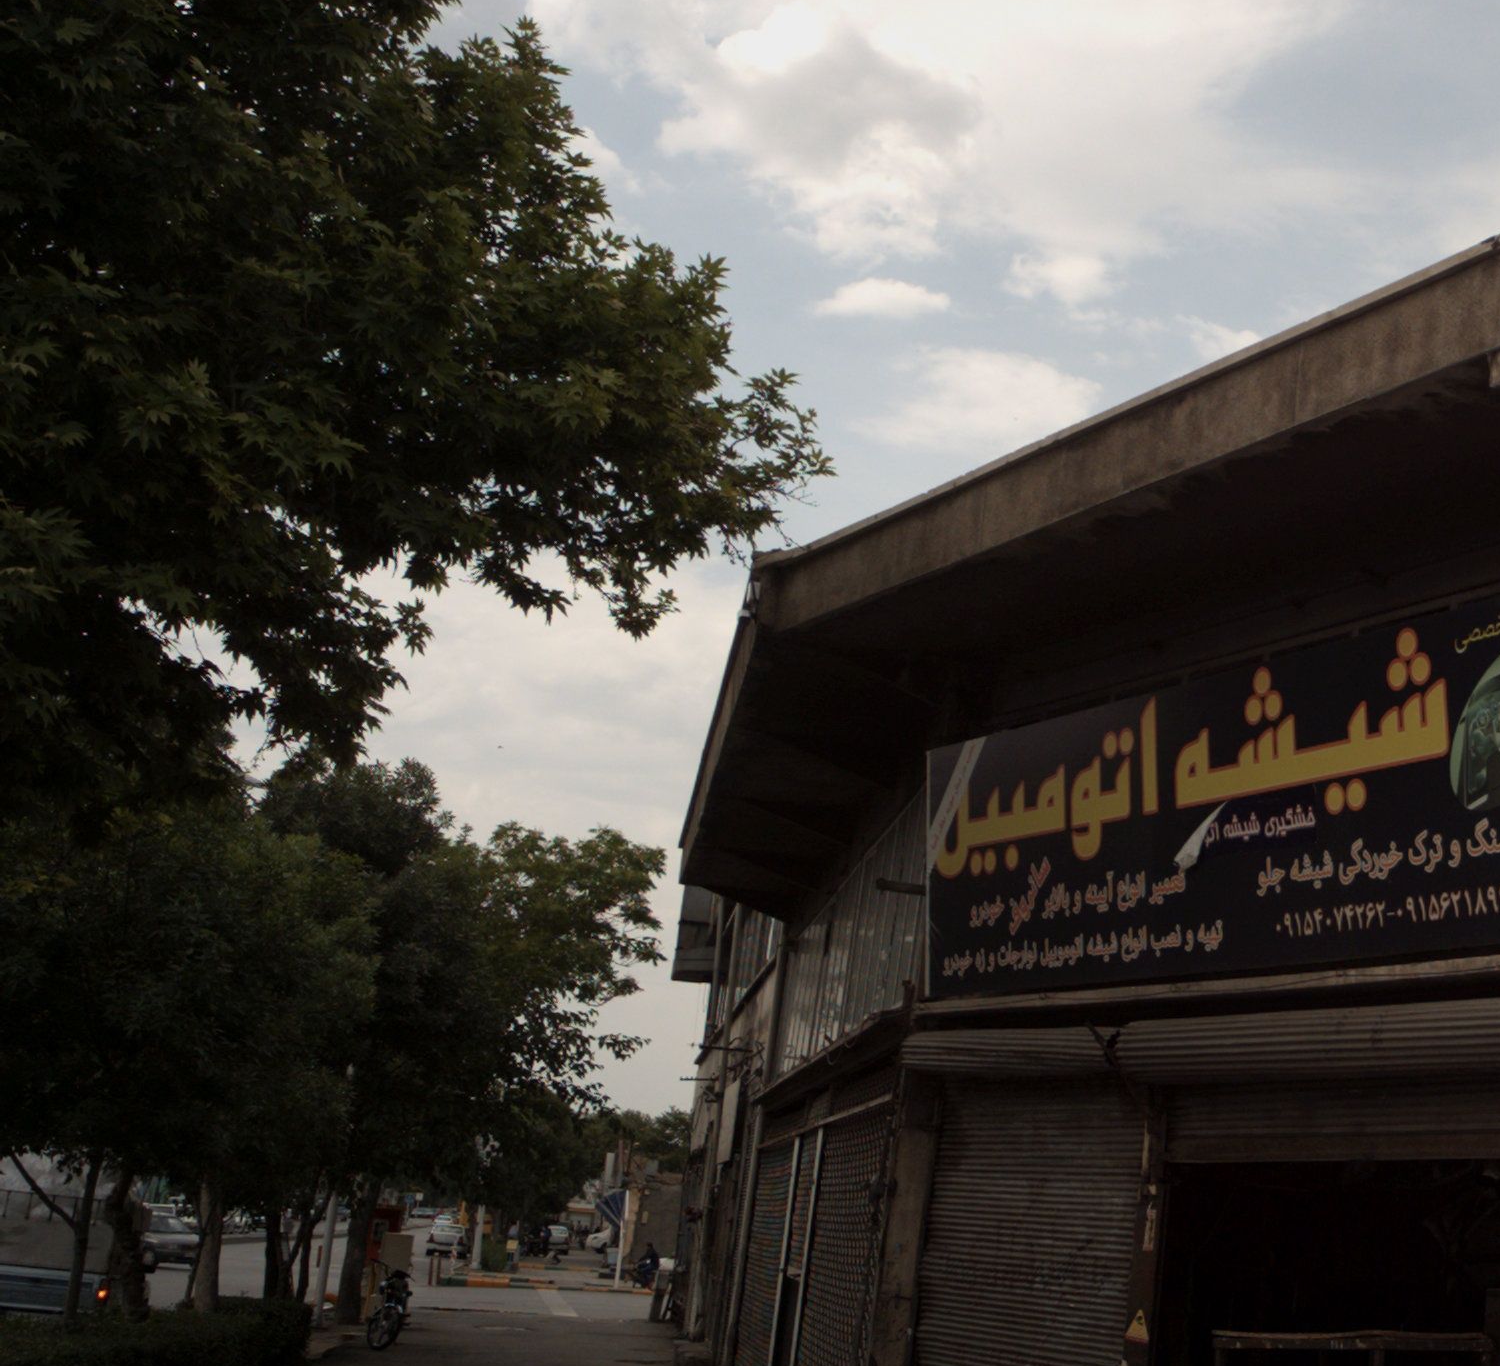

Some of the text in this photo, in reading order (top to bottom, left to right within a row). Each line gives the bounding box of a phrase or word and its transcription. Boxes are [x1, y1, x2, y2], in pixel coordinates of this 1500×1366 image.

[1173, 626, 1452, 816] شیشه
[934, 694, 1160, 879] اتومبیل
[1222, 810, 1261, 843] شیشه
[1289, 849, 1334, 890] شیشه
[1338, 837, 1404, 886] خوردگی
[1407, 828, 1444, 873] ترک
[1447, 842, 1462, 868] و
[1116, 870, 1147, 913] انواع
[1256, 856, 1287, 898] جلو
[1072, 889, 1082, 915] و
[1086, 930, 1119, 963] شیشه
[1120, 923, 1148, 963] انواع
[1150, 923, 1183, 958] نصب
[1184, 928, 1195, 953] و
[1196, 918, 1224, 952] تهیه
